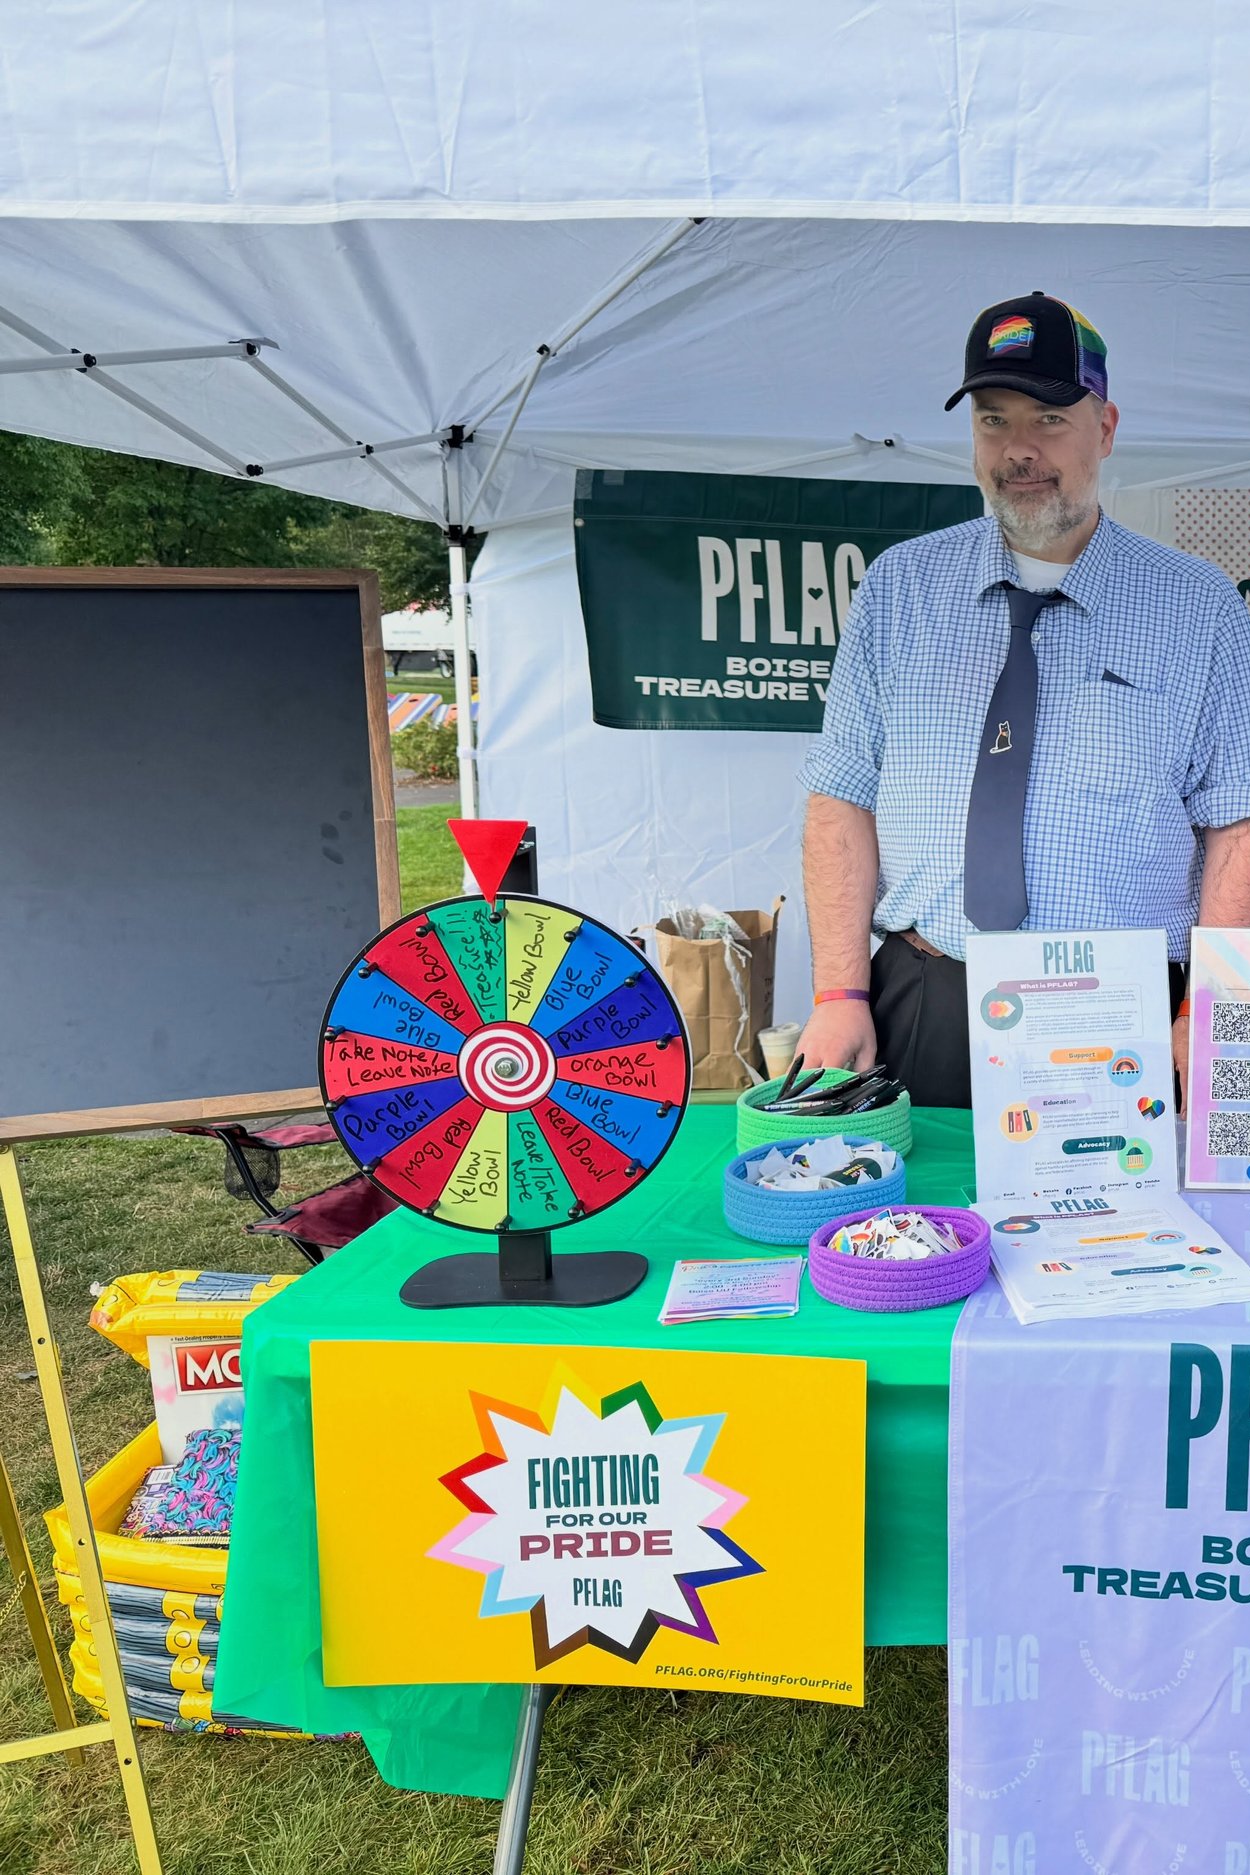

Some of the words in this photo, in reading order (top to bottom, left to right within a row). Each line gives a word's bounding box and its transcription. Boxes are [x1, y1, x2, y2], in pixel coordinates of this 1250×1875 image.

[726, 657, 831, 679] BOISE
[634, 676, 809, 701] TREASURE
[399, 938, 448, 982] Bowl
[509, 960, 537, 1010] Yellow
[524, 913, 551, 958] Bowl
[1043, 940, 1094, 974] PFLAG
[545, 967, 582, 1010] Blue
[576, 952, 612, 1000] Bowl
[373, 991, 424, 1021] Bowl
[424, 989, 465, 1021] Red
[611, 993, 657, 1039] Bowl
[396, 1020, 440, 1048] Blue
[558, 1004, 618, 1049] Purple
[330, 1039, 375, 1061] Take
[1068, 1052, 1096, 1060] Support
[348, 1067, 406, 1087] Leave
[411, 1062, 453, 1078] Note
[605, 1070, 656, 1087] Bowl
[565, 1083, 613, 1114] Blue
[1043, 1098, 1077, 1106] Education
[344, 1091, 419, 1141] Purple
[386, 1099, 435, 1141] Bowl
[591, 1113, 641, 1144] Bowl
[443, 1117, 472, 1149] Red
[545, 1107, 579, 1139] Red
[567, 1137, 616, 1182] Bowl
[1078, 1141, 1111, 1149] Advocacy
[398, 1141, 443, 1190] Bowl
[449, 1152, 481, 1204] Yellow
[480, 1150, 501, 1197] Bowl
[511, 1159, 532, 1203] Note
[1050, 1198, 1110, 1213] PFLAG
[527, 1453, 660, 1510] FIGHTING
[545, 1513, 595, 1529] FOR
[598, 1511, 648, 1527] OUR
[519, 1529, 674, 1562] PRIDE
[572, 1577, 623, 1608] PFLAG
[654, 1664, 854, 1694] PFLAG.ORG/FightingForOurPride
[1080, 1639, 1125, 1699] LEADING
[1127, 1684, 1171, 1702] WITH
[1170, 1647, 1195, 1695] LOVE
[977, 1776, 1020, 1800] WITH
[1020, 1737, 1044, 1780] LOVE
[1081, 1729, 1191, 1808] PFLAG
